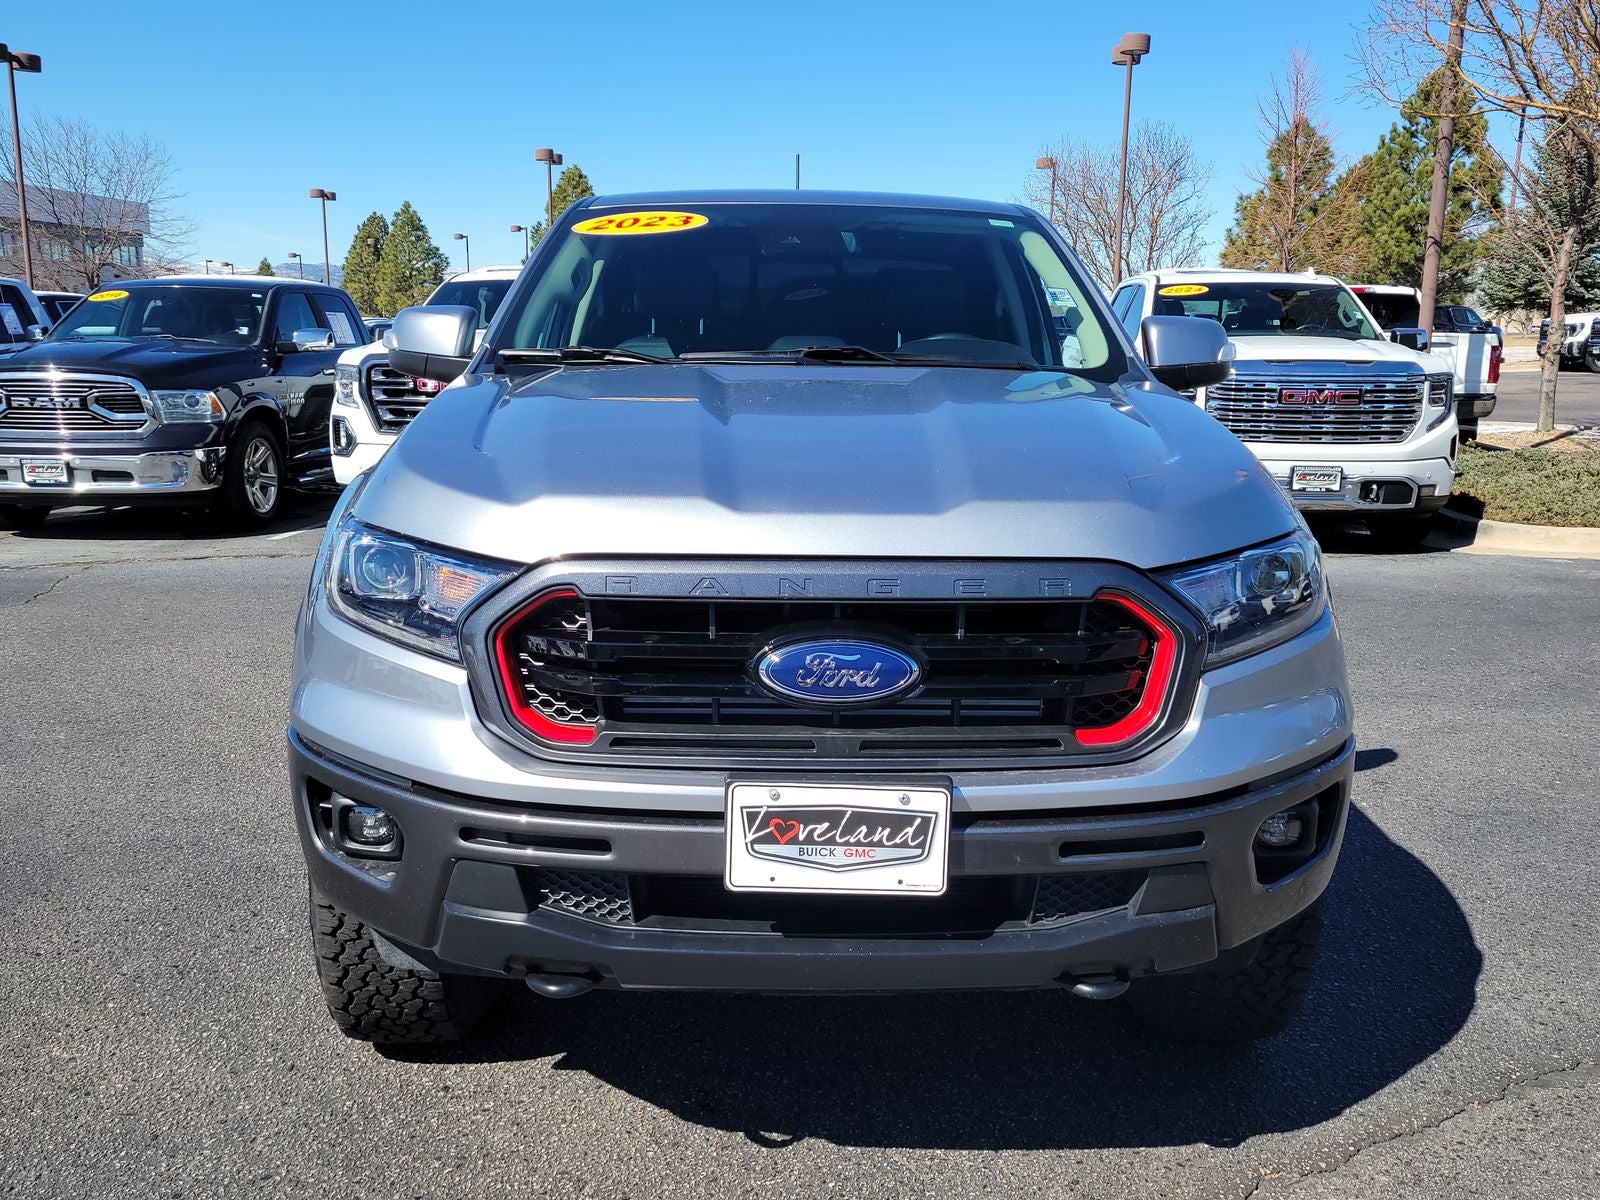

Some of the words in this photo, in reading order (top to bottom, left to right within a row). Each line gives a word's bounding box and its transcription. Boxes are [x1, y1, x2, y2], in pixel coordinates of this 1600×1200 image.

[586, 215, 694, 231] 2023
[10, 396, 80, 408] RAM
[1282, 389, 1360, 404] GMC
[604, 574, 1073, 596] RANGER
[796, 652, 881, 688] Ford
[745, 806, 924, 847] Loveland
[798, 846, 837, 858] BUICK
[843, 848, 877, 859] GMC
